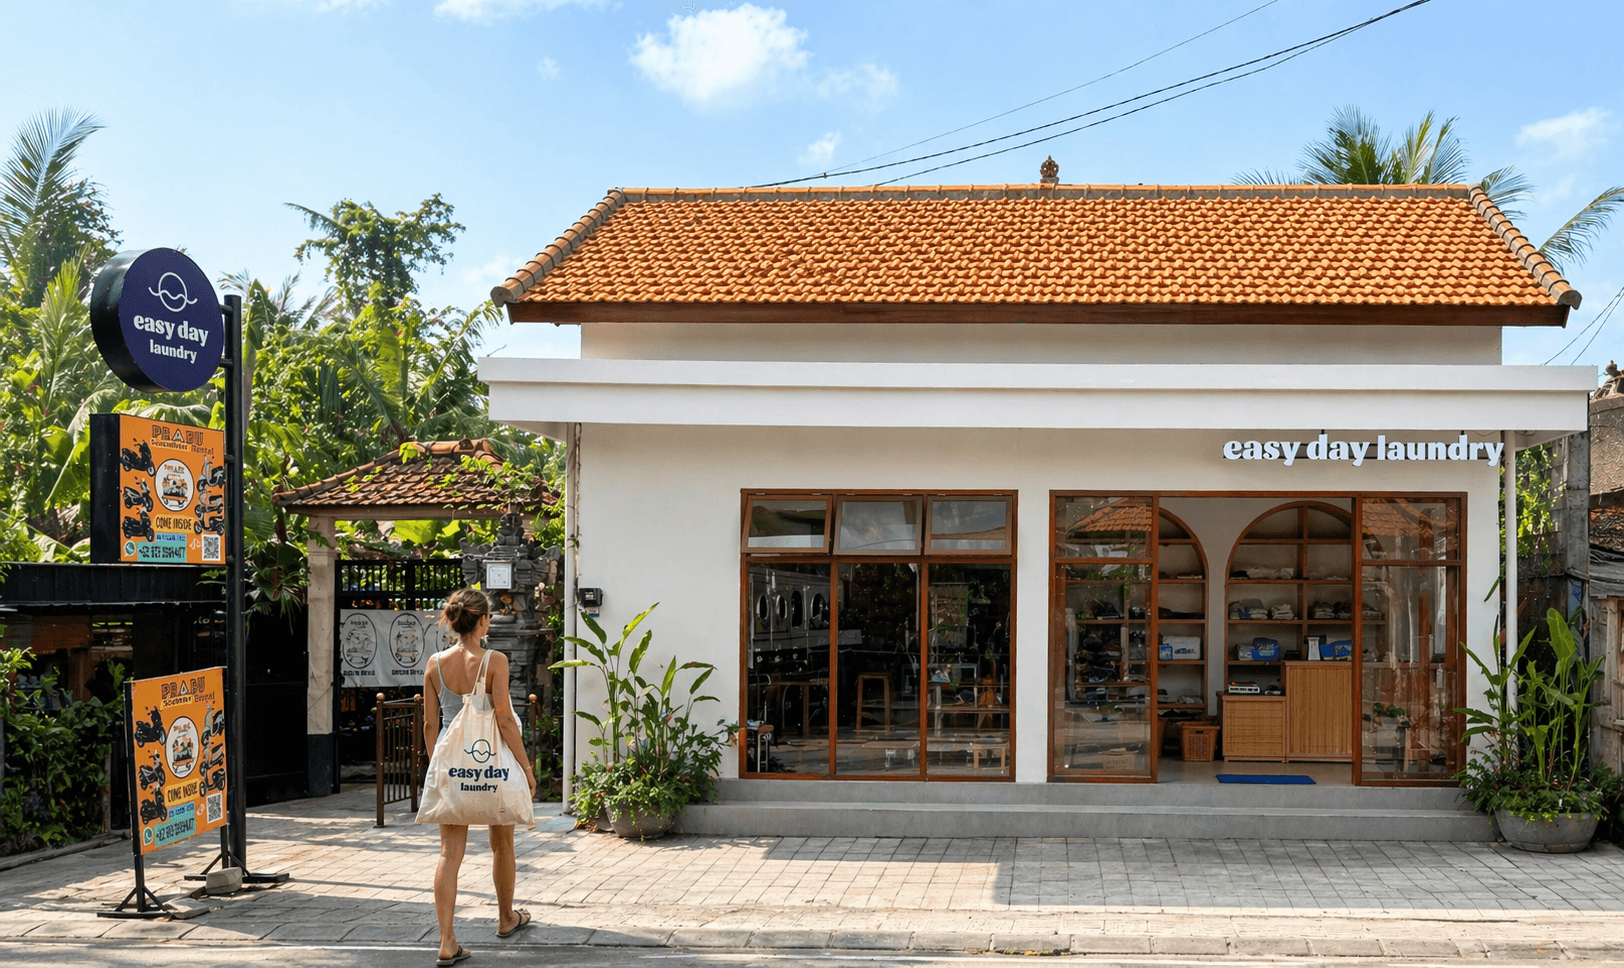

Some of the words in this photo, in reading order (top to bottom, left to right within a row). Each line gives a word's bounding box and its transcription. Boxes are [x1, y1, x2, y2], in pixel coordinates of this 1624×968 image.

[133, 314, 175, 340] easy
[177, 320, 209, 347] day
[149, 338, 197, 364] laundry
[1222, 440, 1301, 466] easy
[1306, 433, 1370, 467] day
[1376, 434, 1504, 467] laundry
[448, 767, 482, 782] easy
[484, 765, 509, 781] day
[460, 782, 498, 793] laundry
